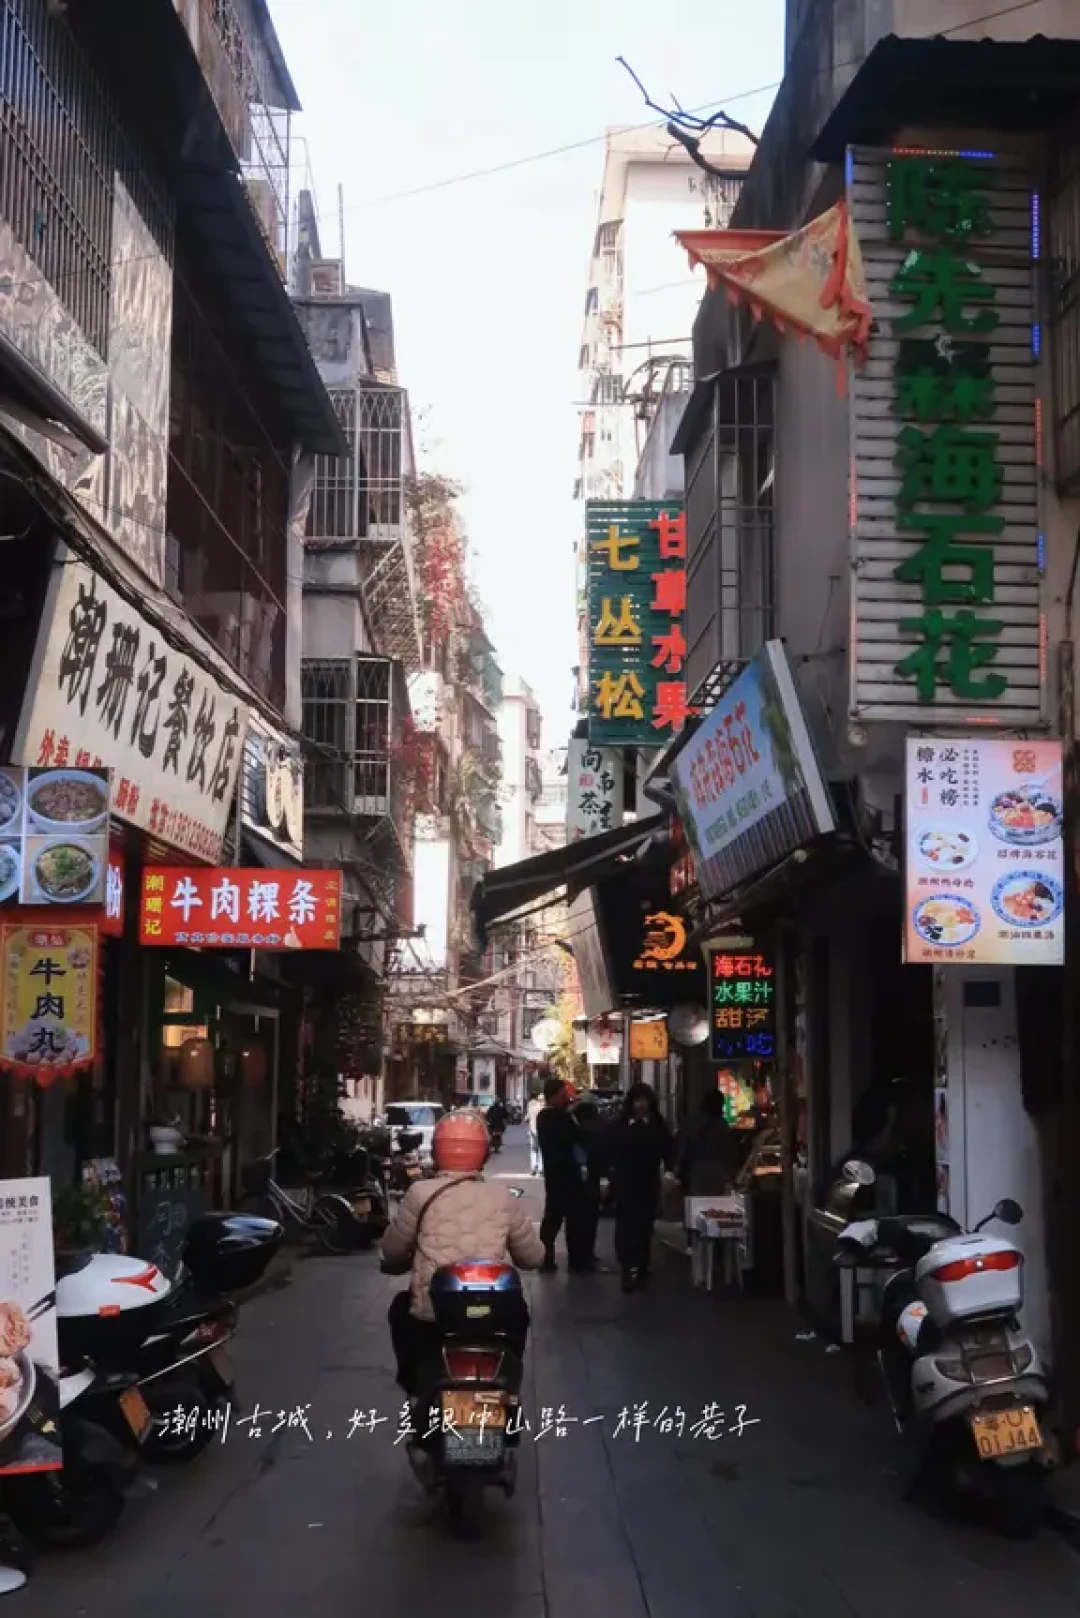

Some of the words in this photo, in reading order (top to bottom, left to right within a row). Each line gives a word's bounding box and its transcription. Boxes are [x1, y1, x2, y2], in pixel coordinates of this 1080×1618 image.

[590, 524, 645, 720] 七丛松
[648, 510, 699, 732] 甘草水果
[58, 572, 240, 803] 潮珊记餐饮店
[939, 747, 960, 807] 必吃榜
[170, 876, 319, 925] 牛肉粿条
[28, 957, 67, 1053] 牛肉丸
[714, 980, 773, 1003] 水果汁
